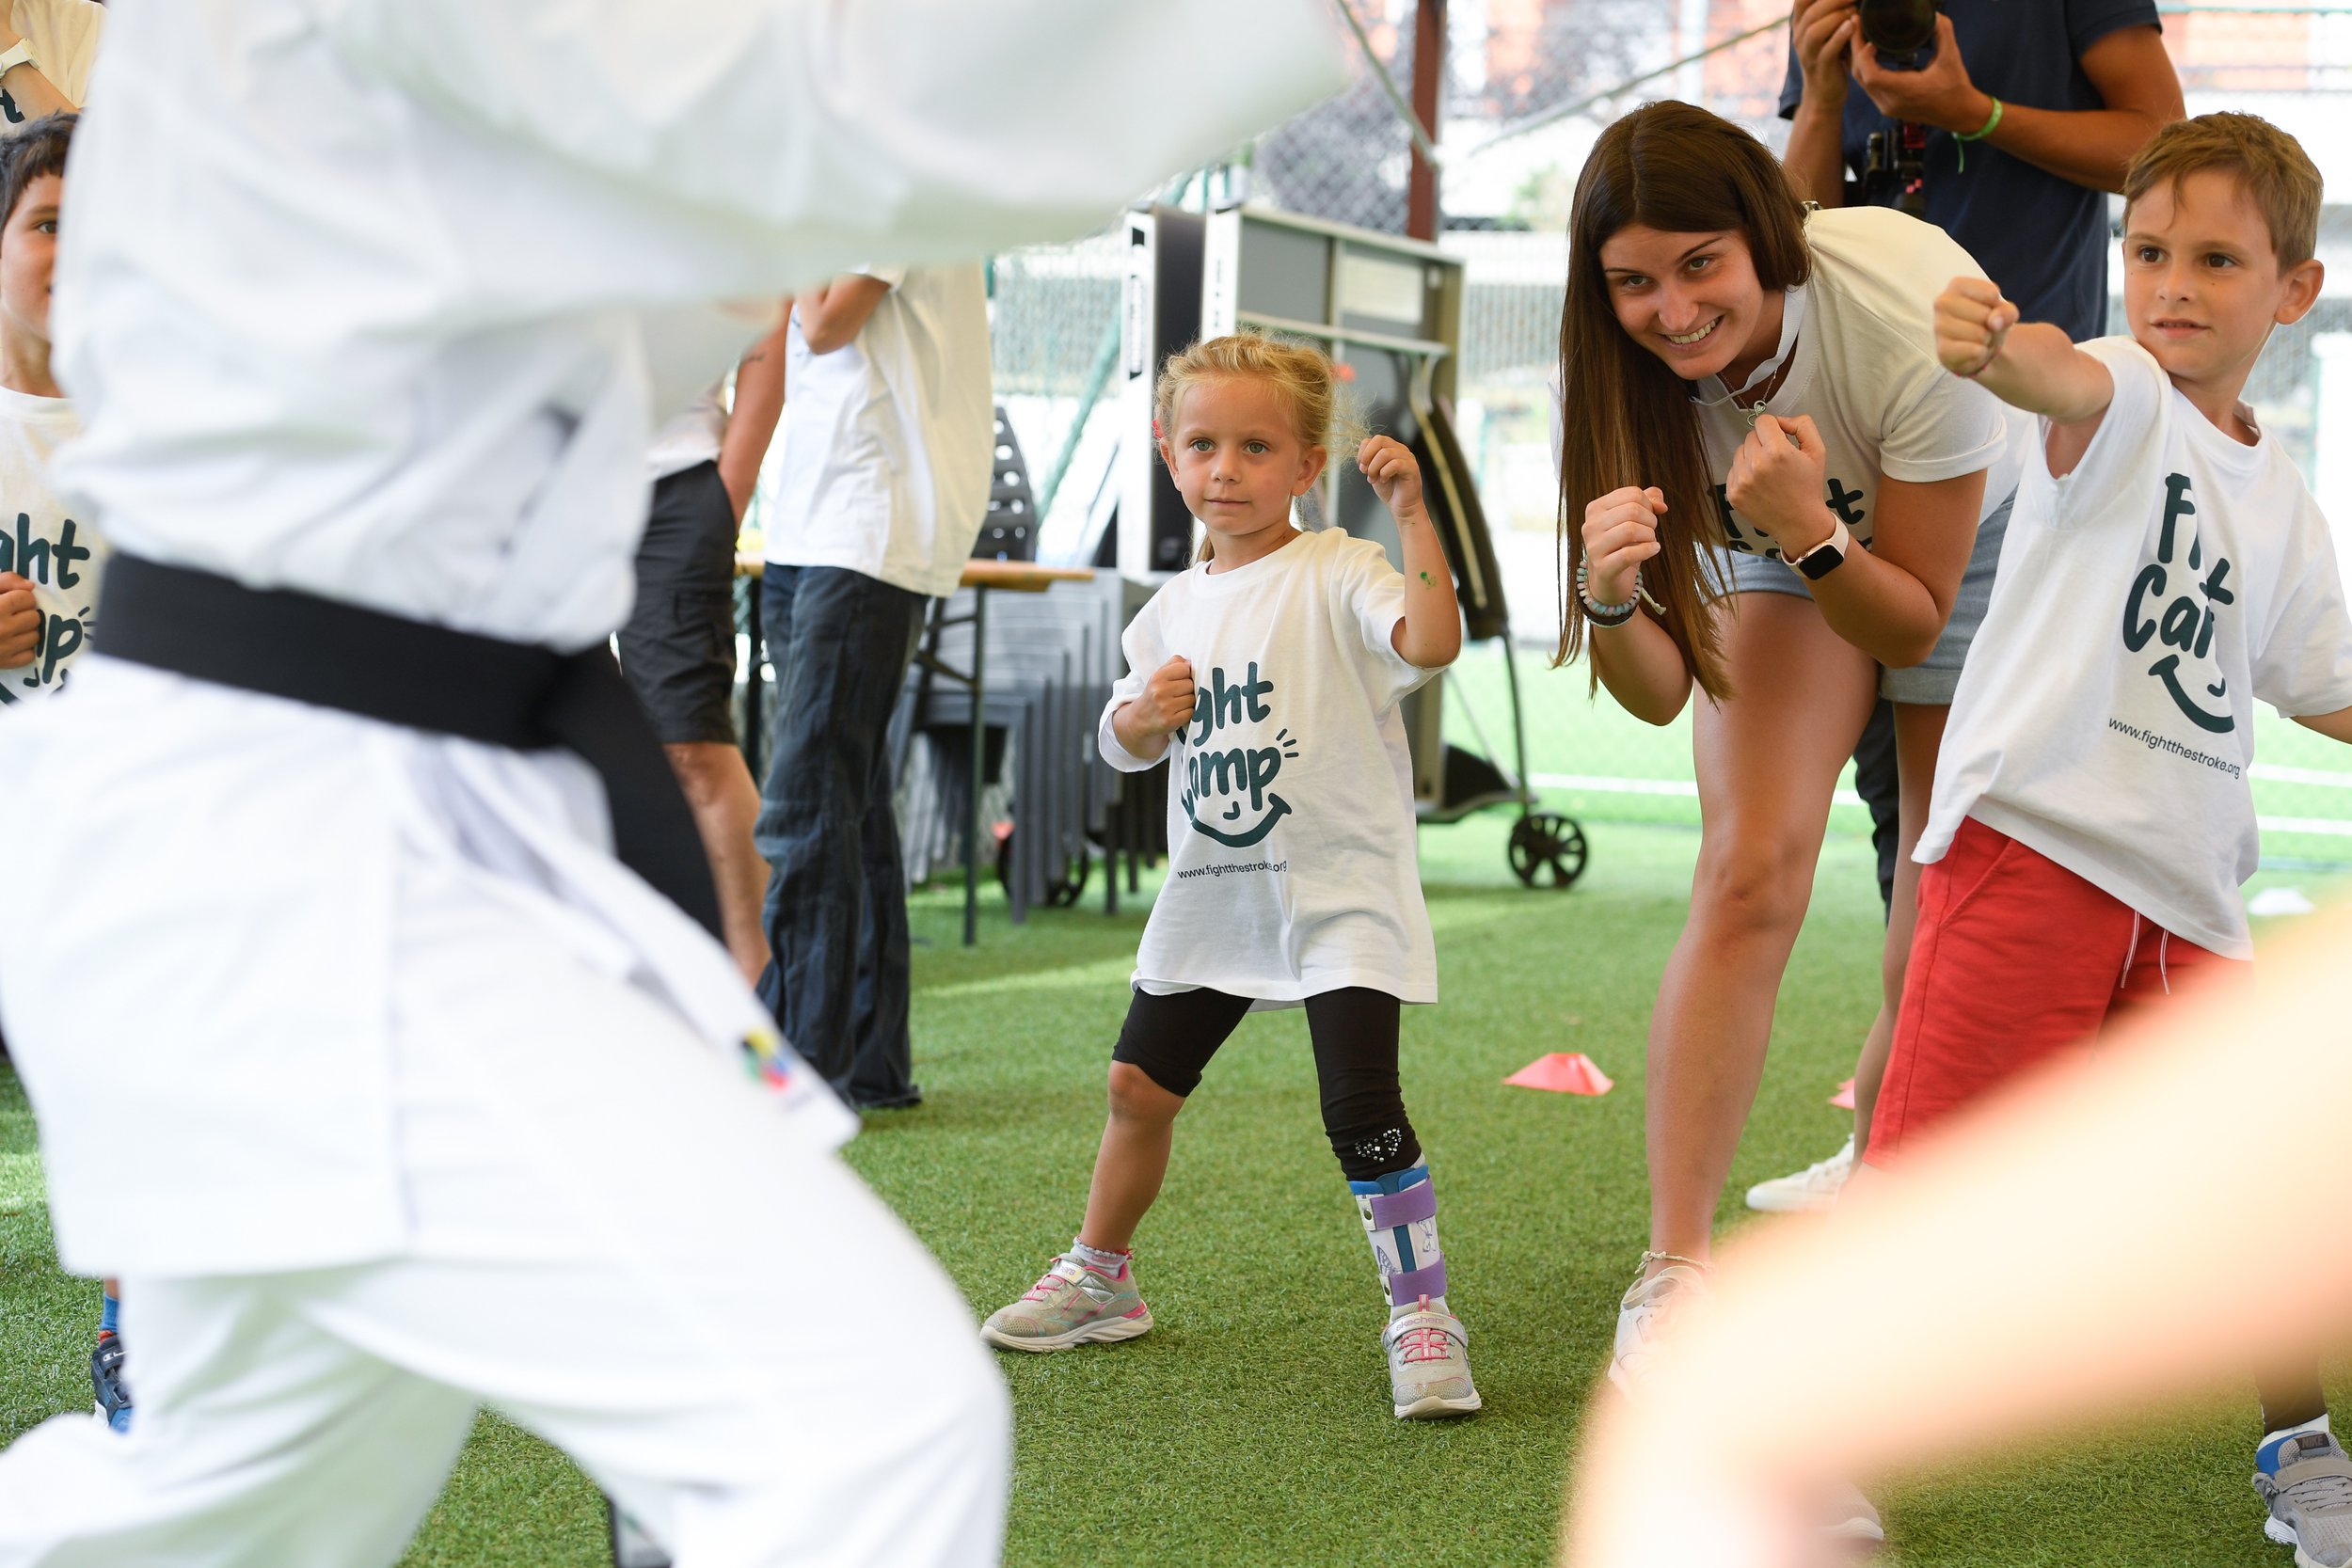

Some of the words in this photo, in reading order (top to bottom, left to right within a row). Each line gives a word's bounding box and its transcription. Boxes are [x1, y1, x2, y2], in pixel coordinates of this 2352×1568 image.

[2108, 718, 2240, 780] www.fightthestroke.org
[1182, 747, 1281, 818] amp
[1396, 1316, 1445, 1331] skechers
[2301, 1436, 2325, 1449] NIKE
